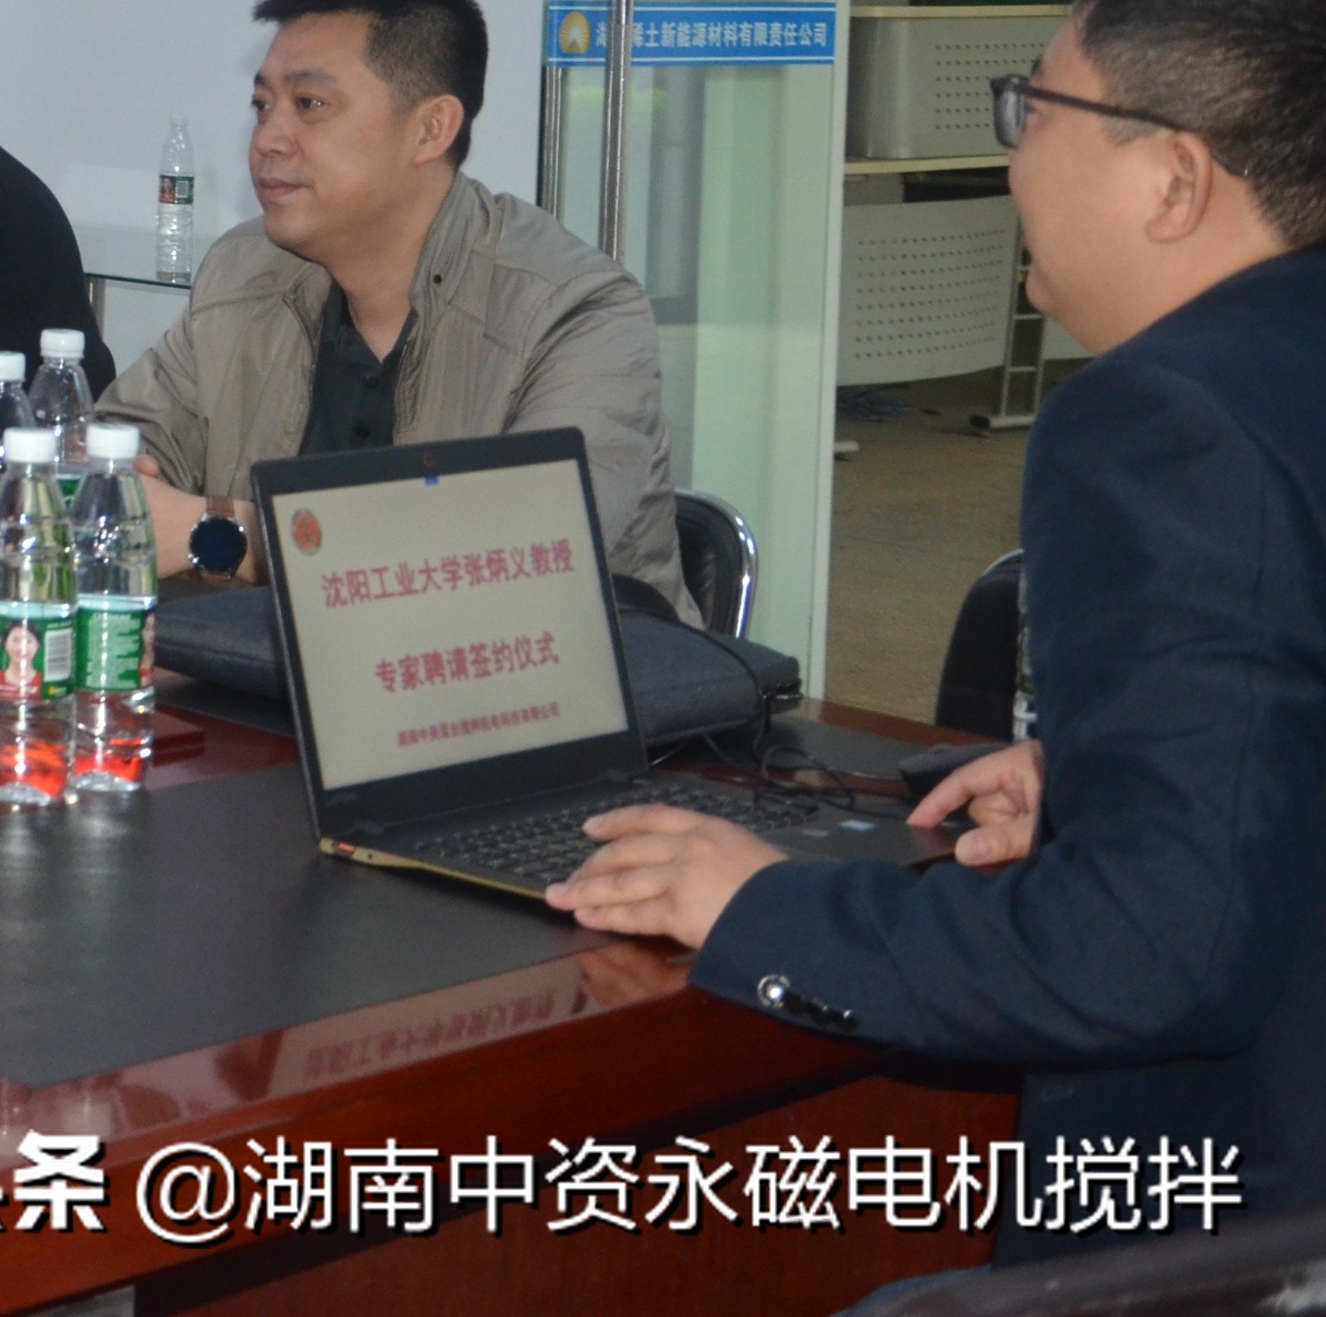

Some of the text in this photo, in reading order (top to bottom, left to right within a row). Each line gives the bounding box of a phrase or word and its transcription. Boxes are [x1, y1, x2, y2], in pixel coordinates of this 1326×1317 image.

[321, 538, 576, 609] 沈阳工业大学张炳义教授
[375, 630, 561, 694] 专家聘请签约仪式
